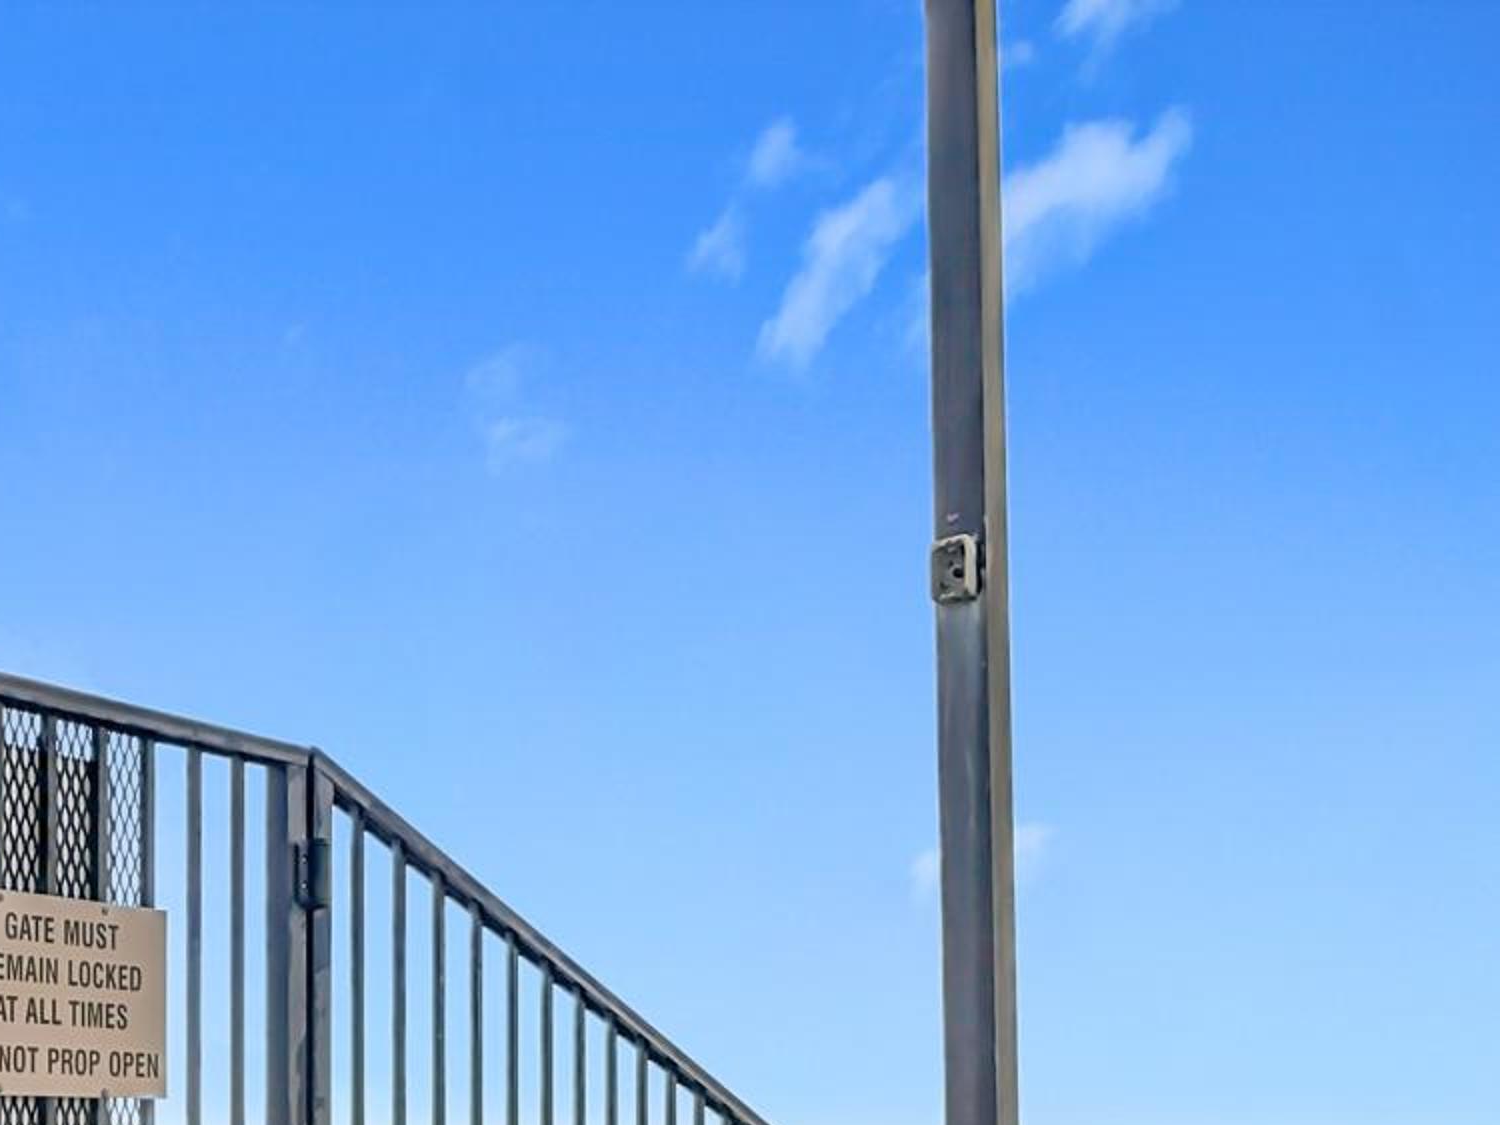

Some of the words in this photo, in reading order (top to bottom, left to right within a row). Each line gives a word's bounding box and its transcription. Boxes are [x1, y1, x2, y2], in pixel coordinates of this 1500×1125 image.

[5, 911, 55, 944] GATE
[63, 919, 120, 951] MUST
[67, 959, 142, 992] LOCKED
[25, 997, 63, 1026] ALL
[68, 1000, 128, 1031] TIMES
[47, 1047, 101, 1076] PROP
[109, 1050, 159, 1079] OPEN
